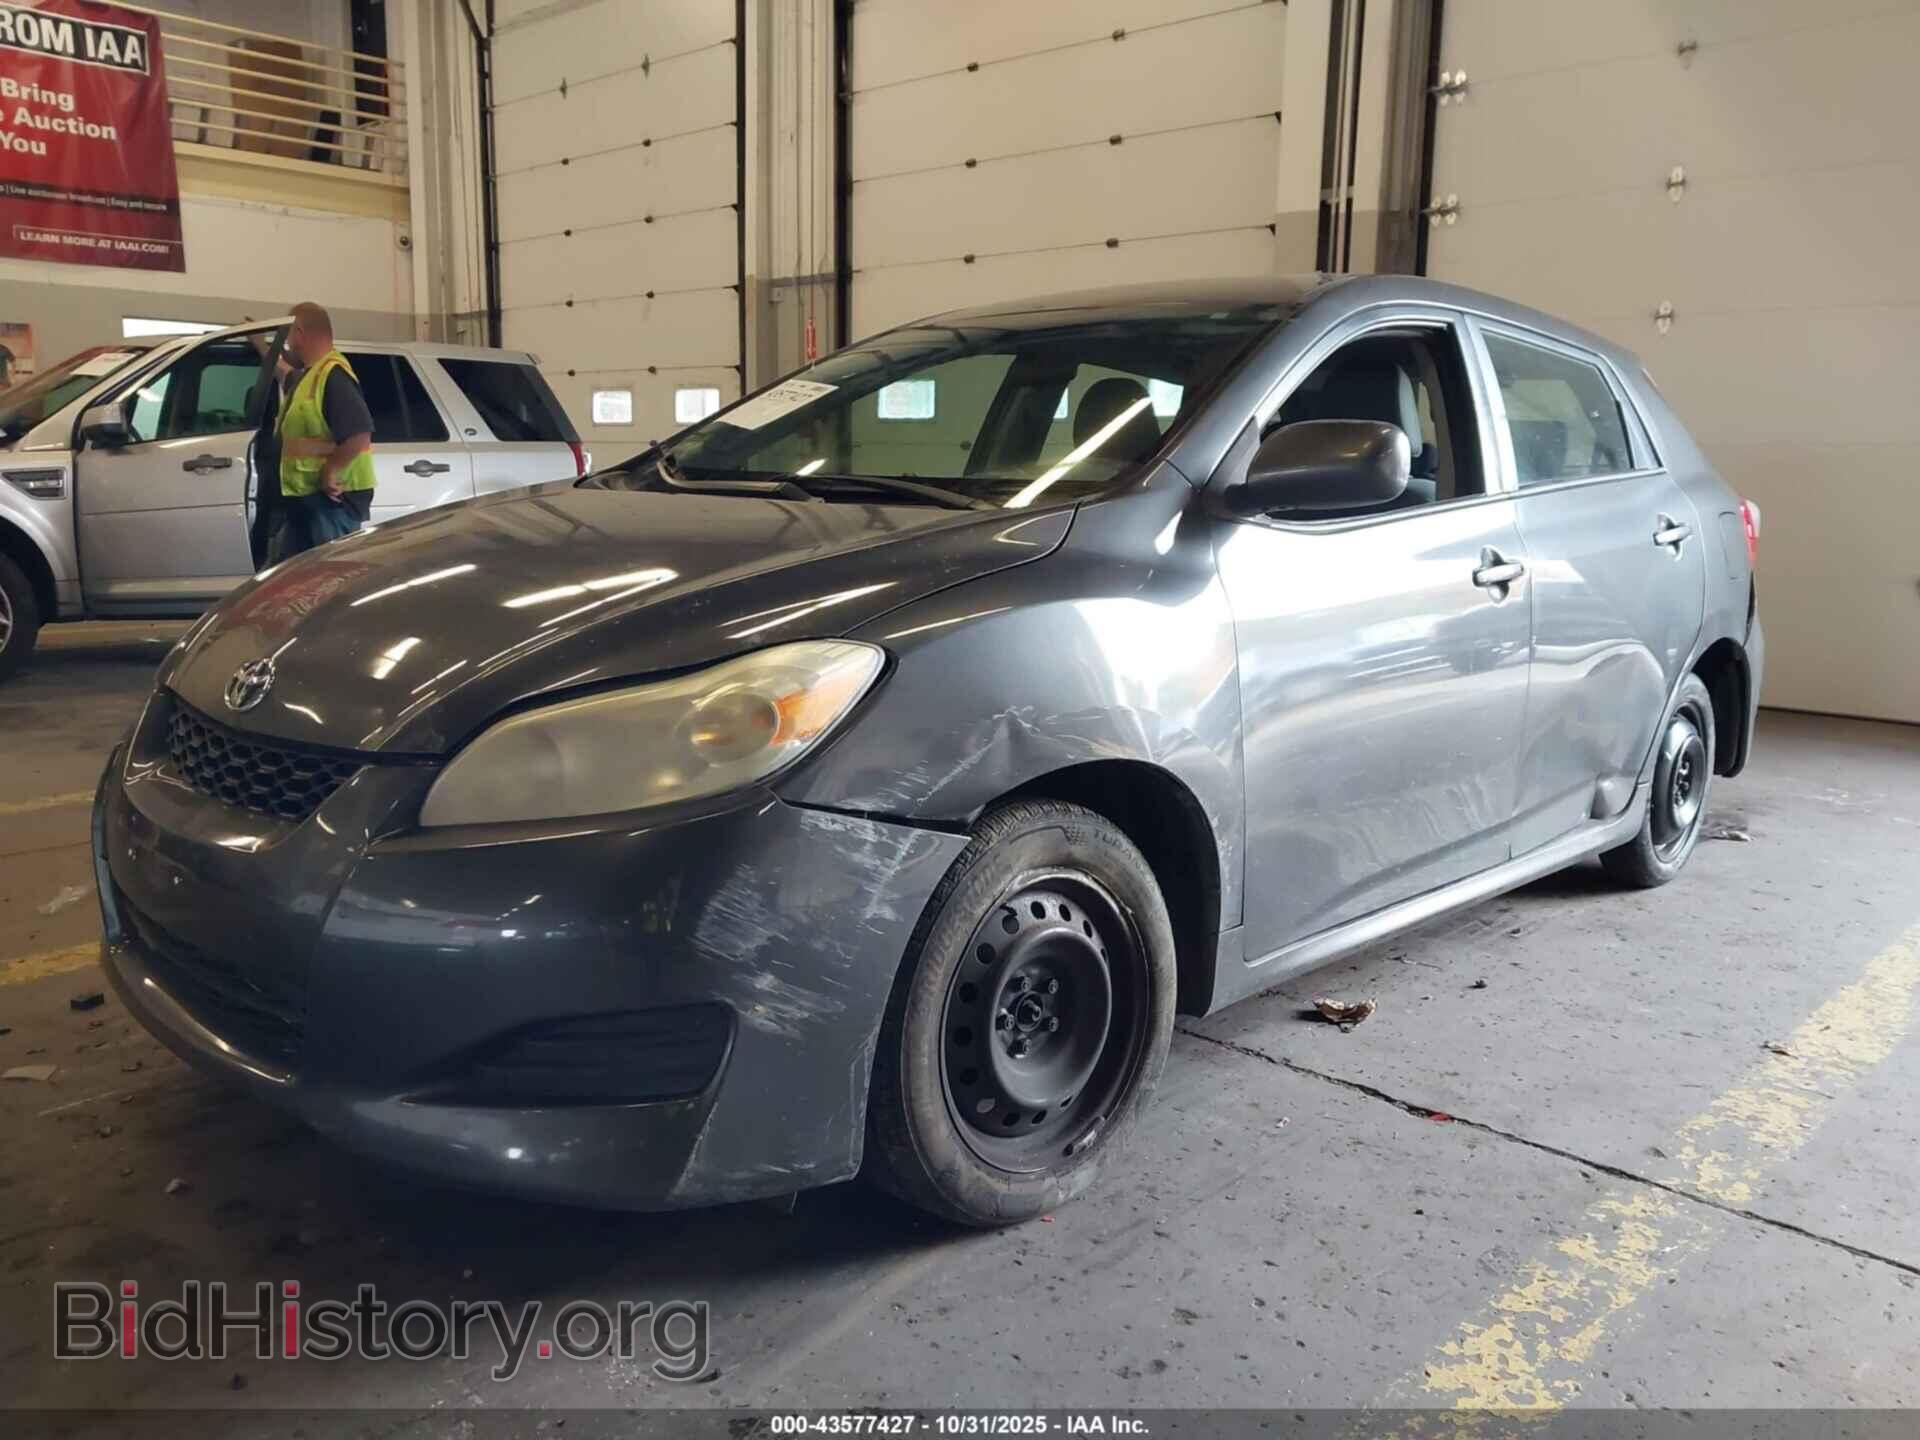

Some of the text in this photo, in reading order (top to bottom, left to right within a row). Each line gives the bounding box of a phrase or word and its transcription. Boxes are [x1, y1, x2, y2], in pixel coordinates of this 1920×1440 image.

[84, 28, 143, 67] IAA
[2, 78, 75, 112] Bring
[14, 107, 117, 140] Auction
[0, 130, 47, 156] You
[20, 231, 60, 243] LEARN
[62, 235, 97, 248] MORE
[97, 240, 112, 249] AT
